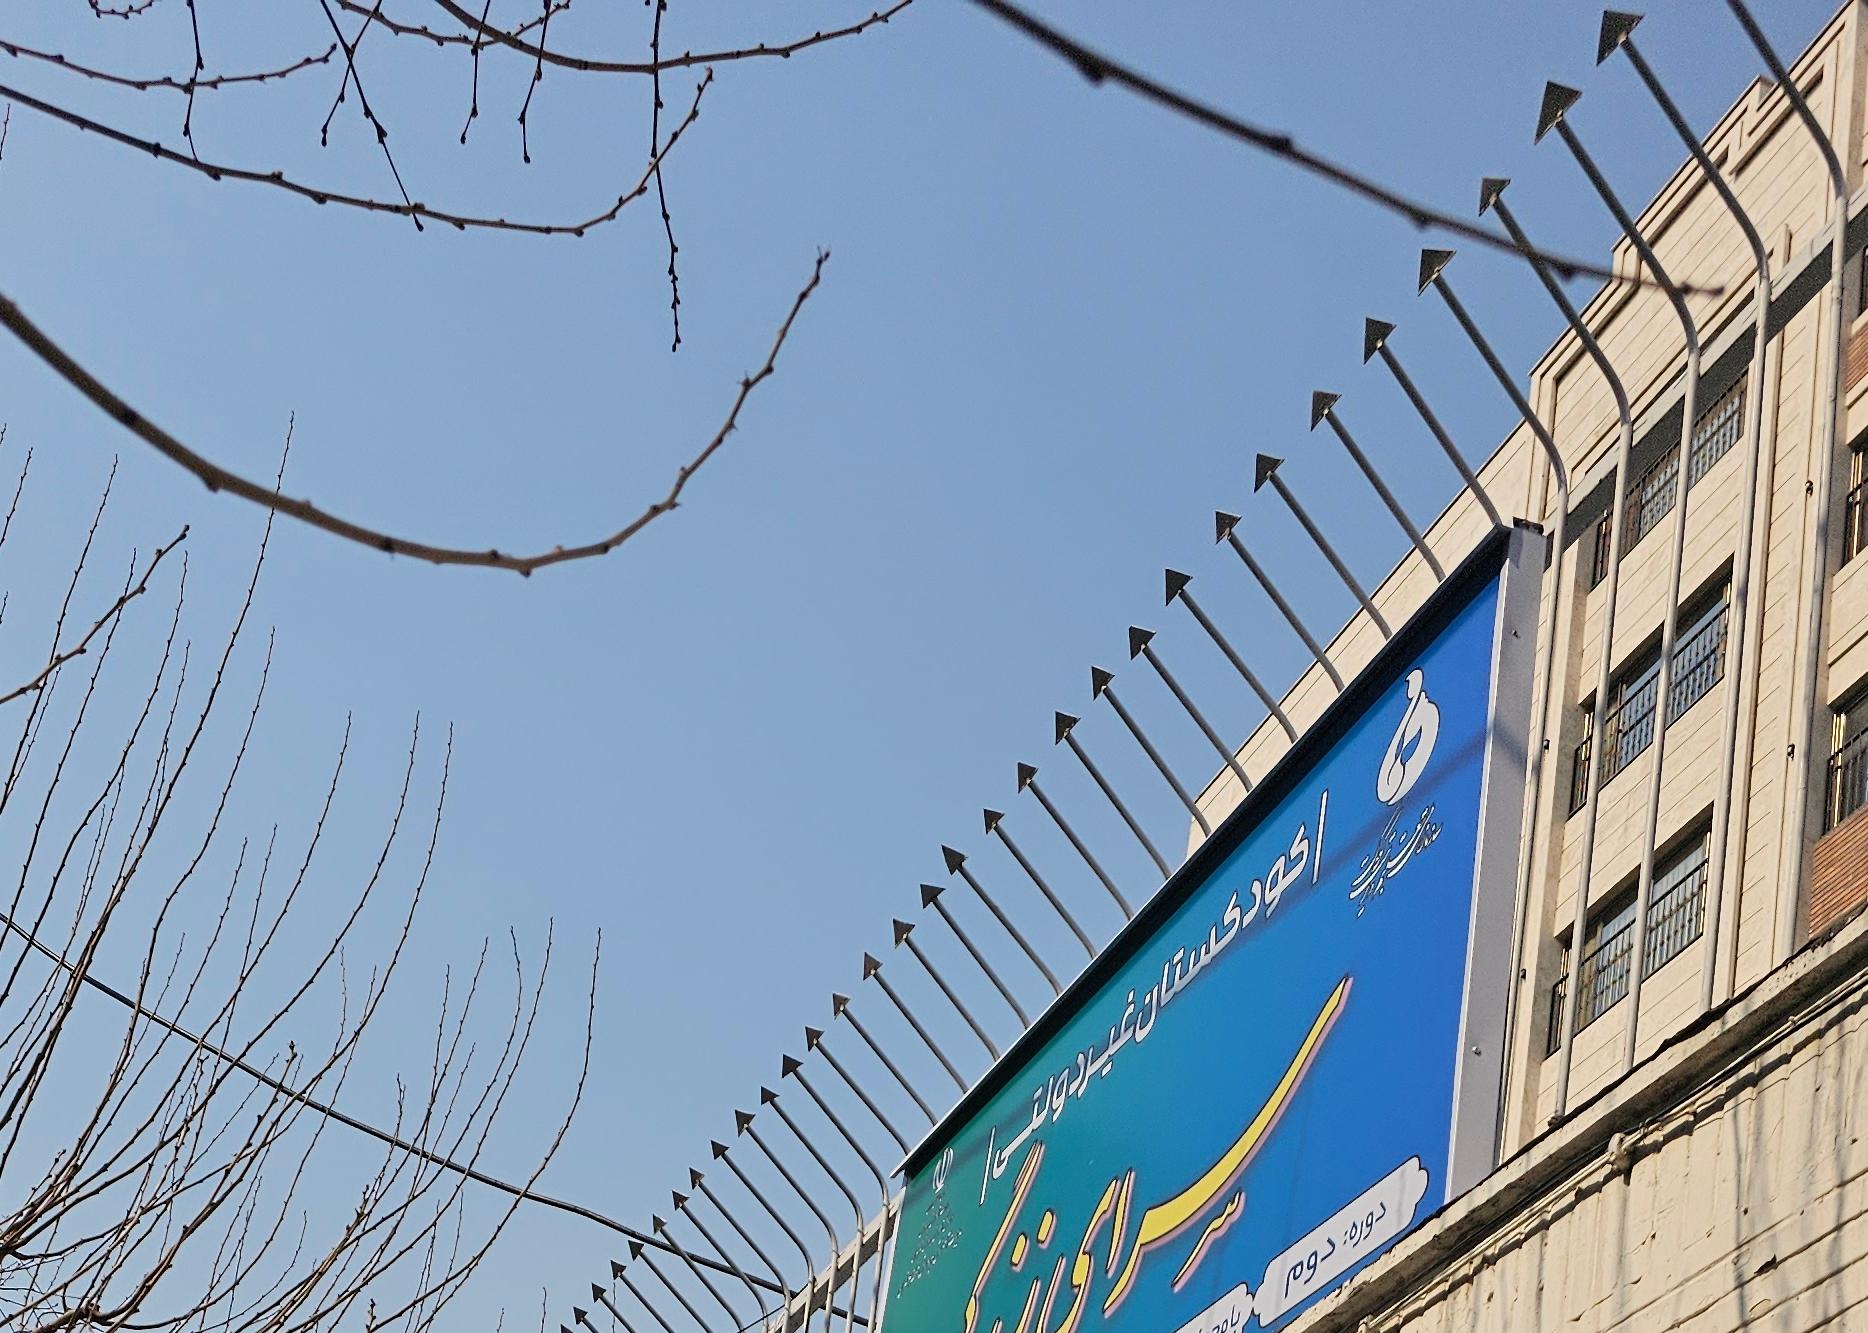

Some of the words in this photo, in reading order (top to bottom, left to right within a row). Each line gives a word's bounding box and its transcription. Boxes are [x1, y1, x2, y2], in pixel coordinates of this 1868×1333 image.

[1134, 823, 1311, 1044] کودکستان
[1343, 1201, 1387, 1248] دوره:
[1284, 1237, 1337, 1299] دوم
